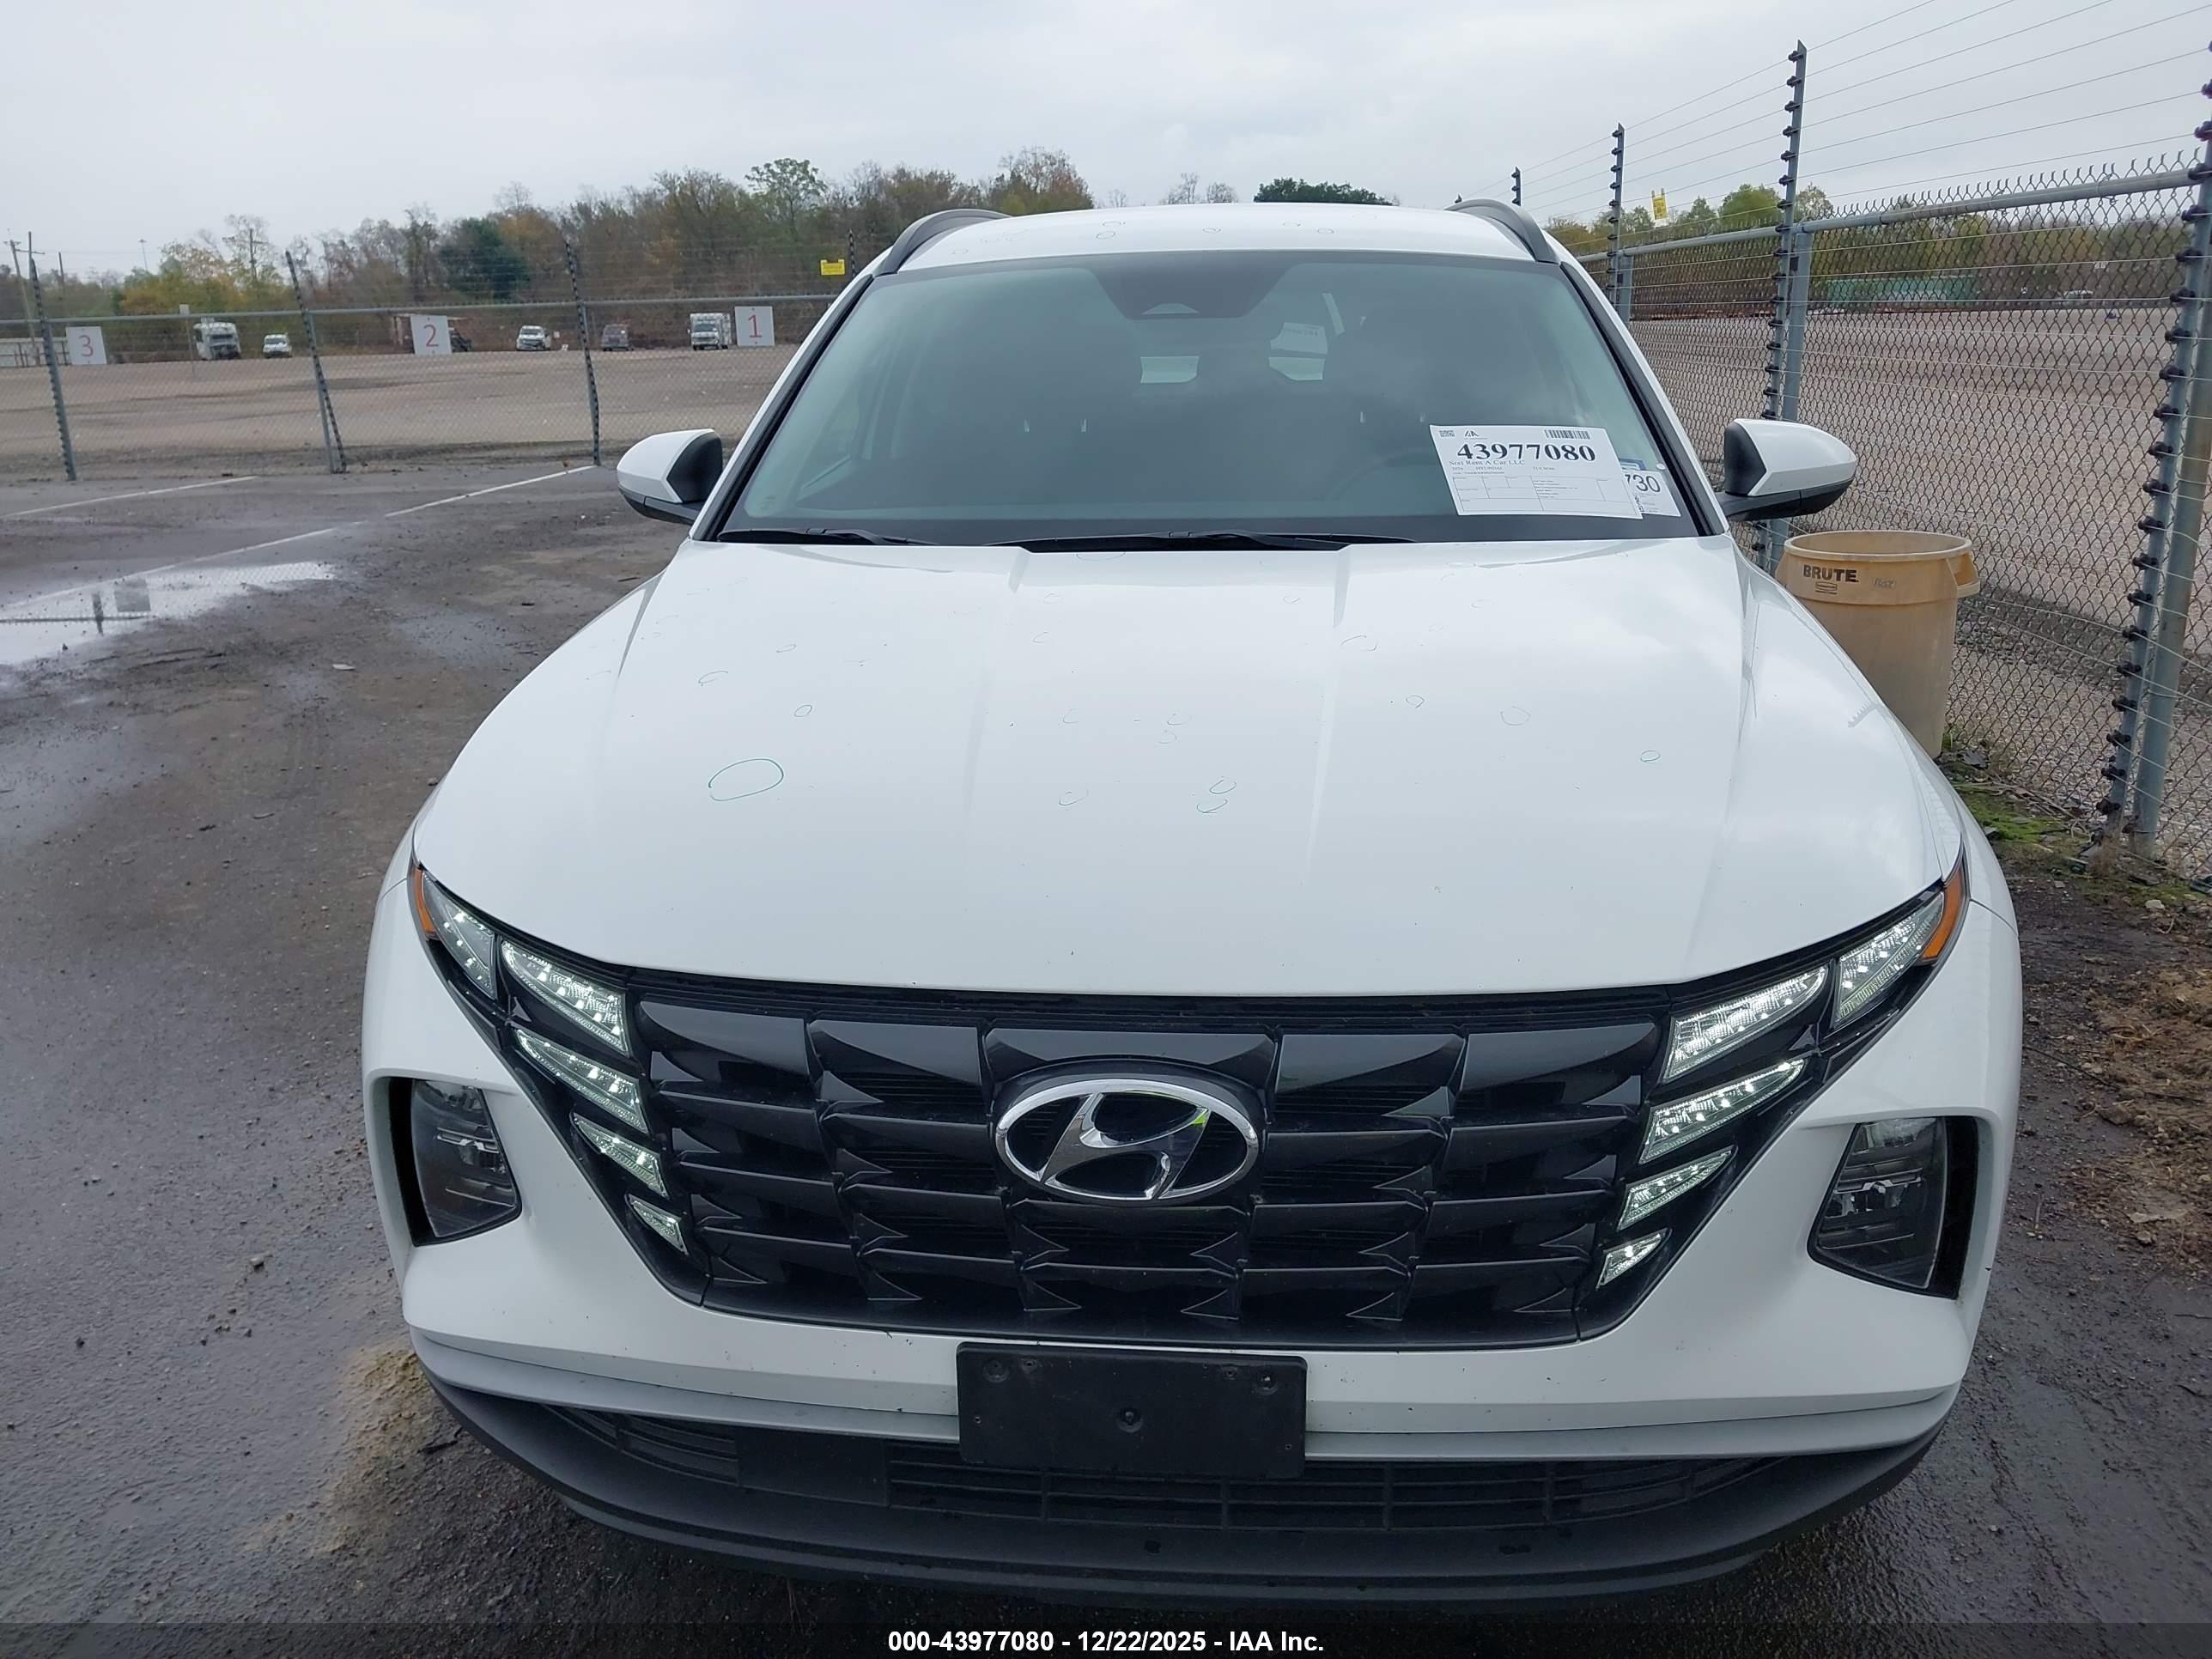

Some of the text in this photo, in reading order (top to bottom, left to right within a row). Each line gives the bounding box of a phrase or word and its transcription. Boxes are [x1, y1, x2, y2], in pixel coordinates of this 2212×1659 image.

[423, 324, 440, 348] 2
[748, 314, 763, 338] 1
[78, 335, 94, 357] 3
[1457, 443, 1595, 461] 43977080
[1803, 564, 1859, 582] BRUTE
